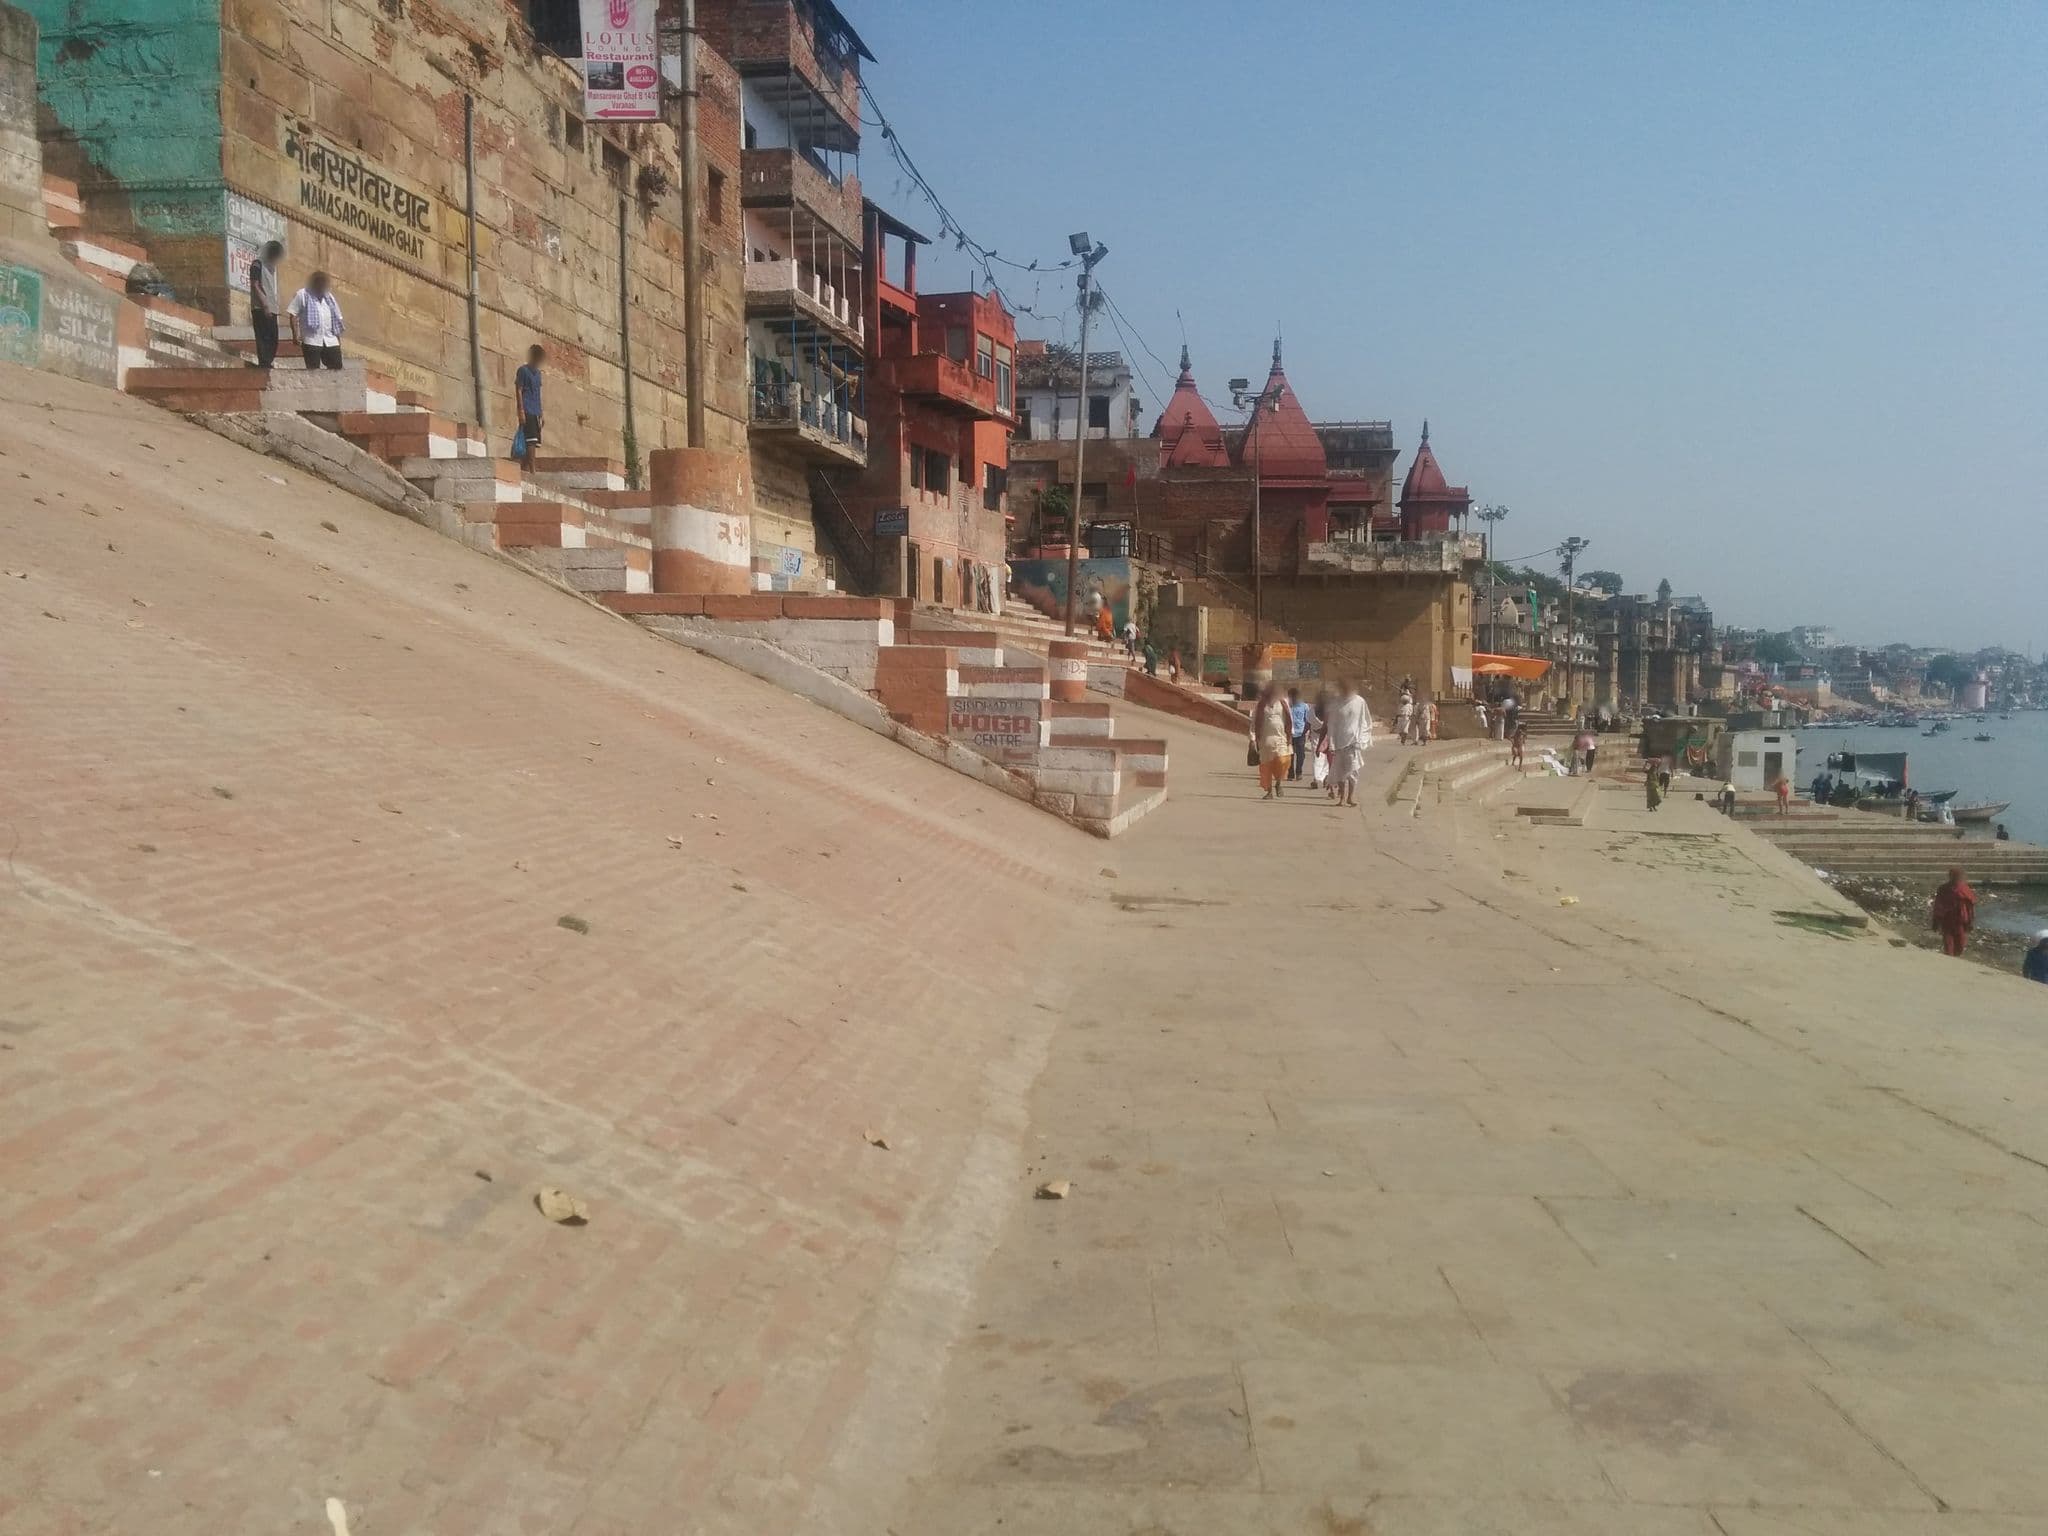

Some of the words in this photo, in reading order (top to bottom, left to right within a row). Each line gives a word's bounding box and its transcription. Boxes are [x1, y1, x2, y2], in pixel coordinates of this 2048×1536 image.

[585, 31, 654, 46] LOTUS
[586, 51, 655, 61] Restaurant
[300, 178, 396, 247] MANASAROWAR
[395, 228, 425, 260] GHAT
[59, 316, 99, 344] SILK
[951, 713, 1031, 734] YOGA
[973, 734, 1023, 747] CENTRE
